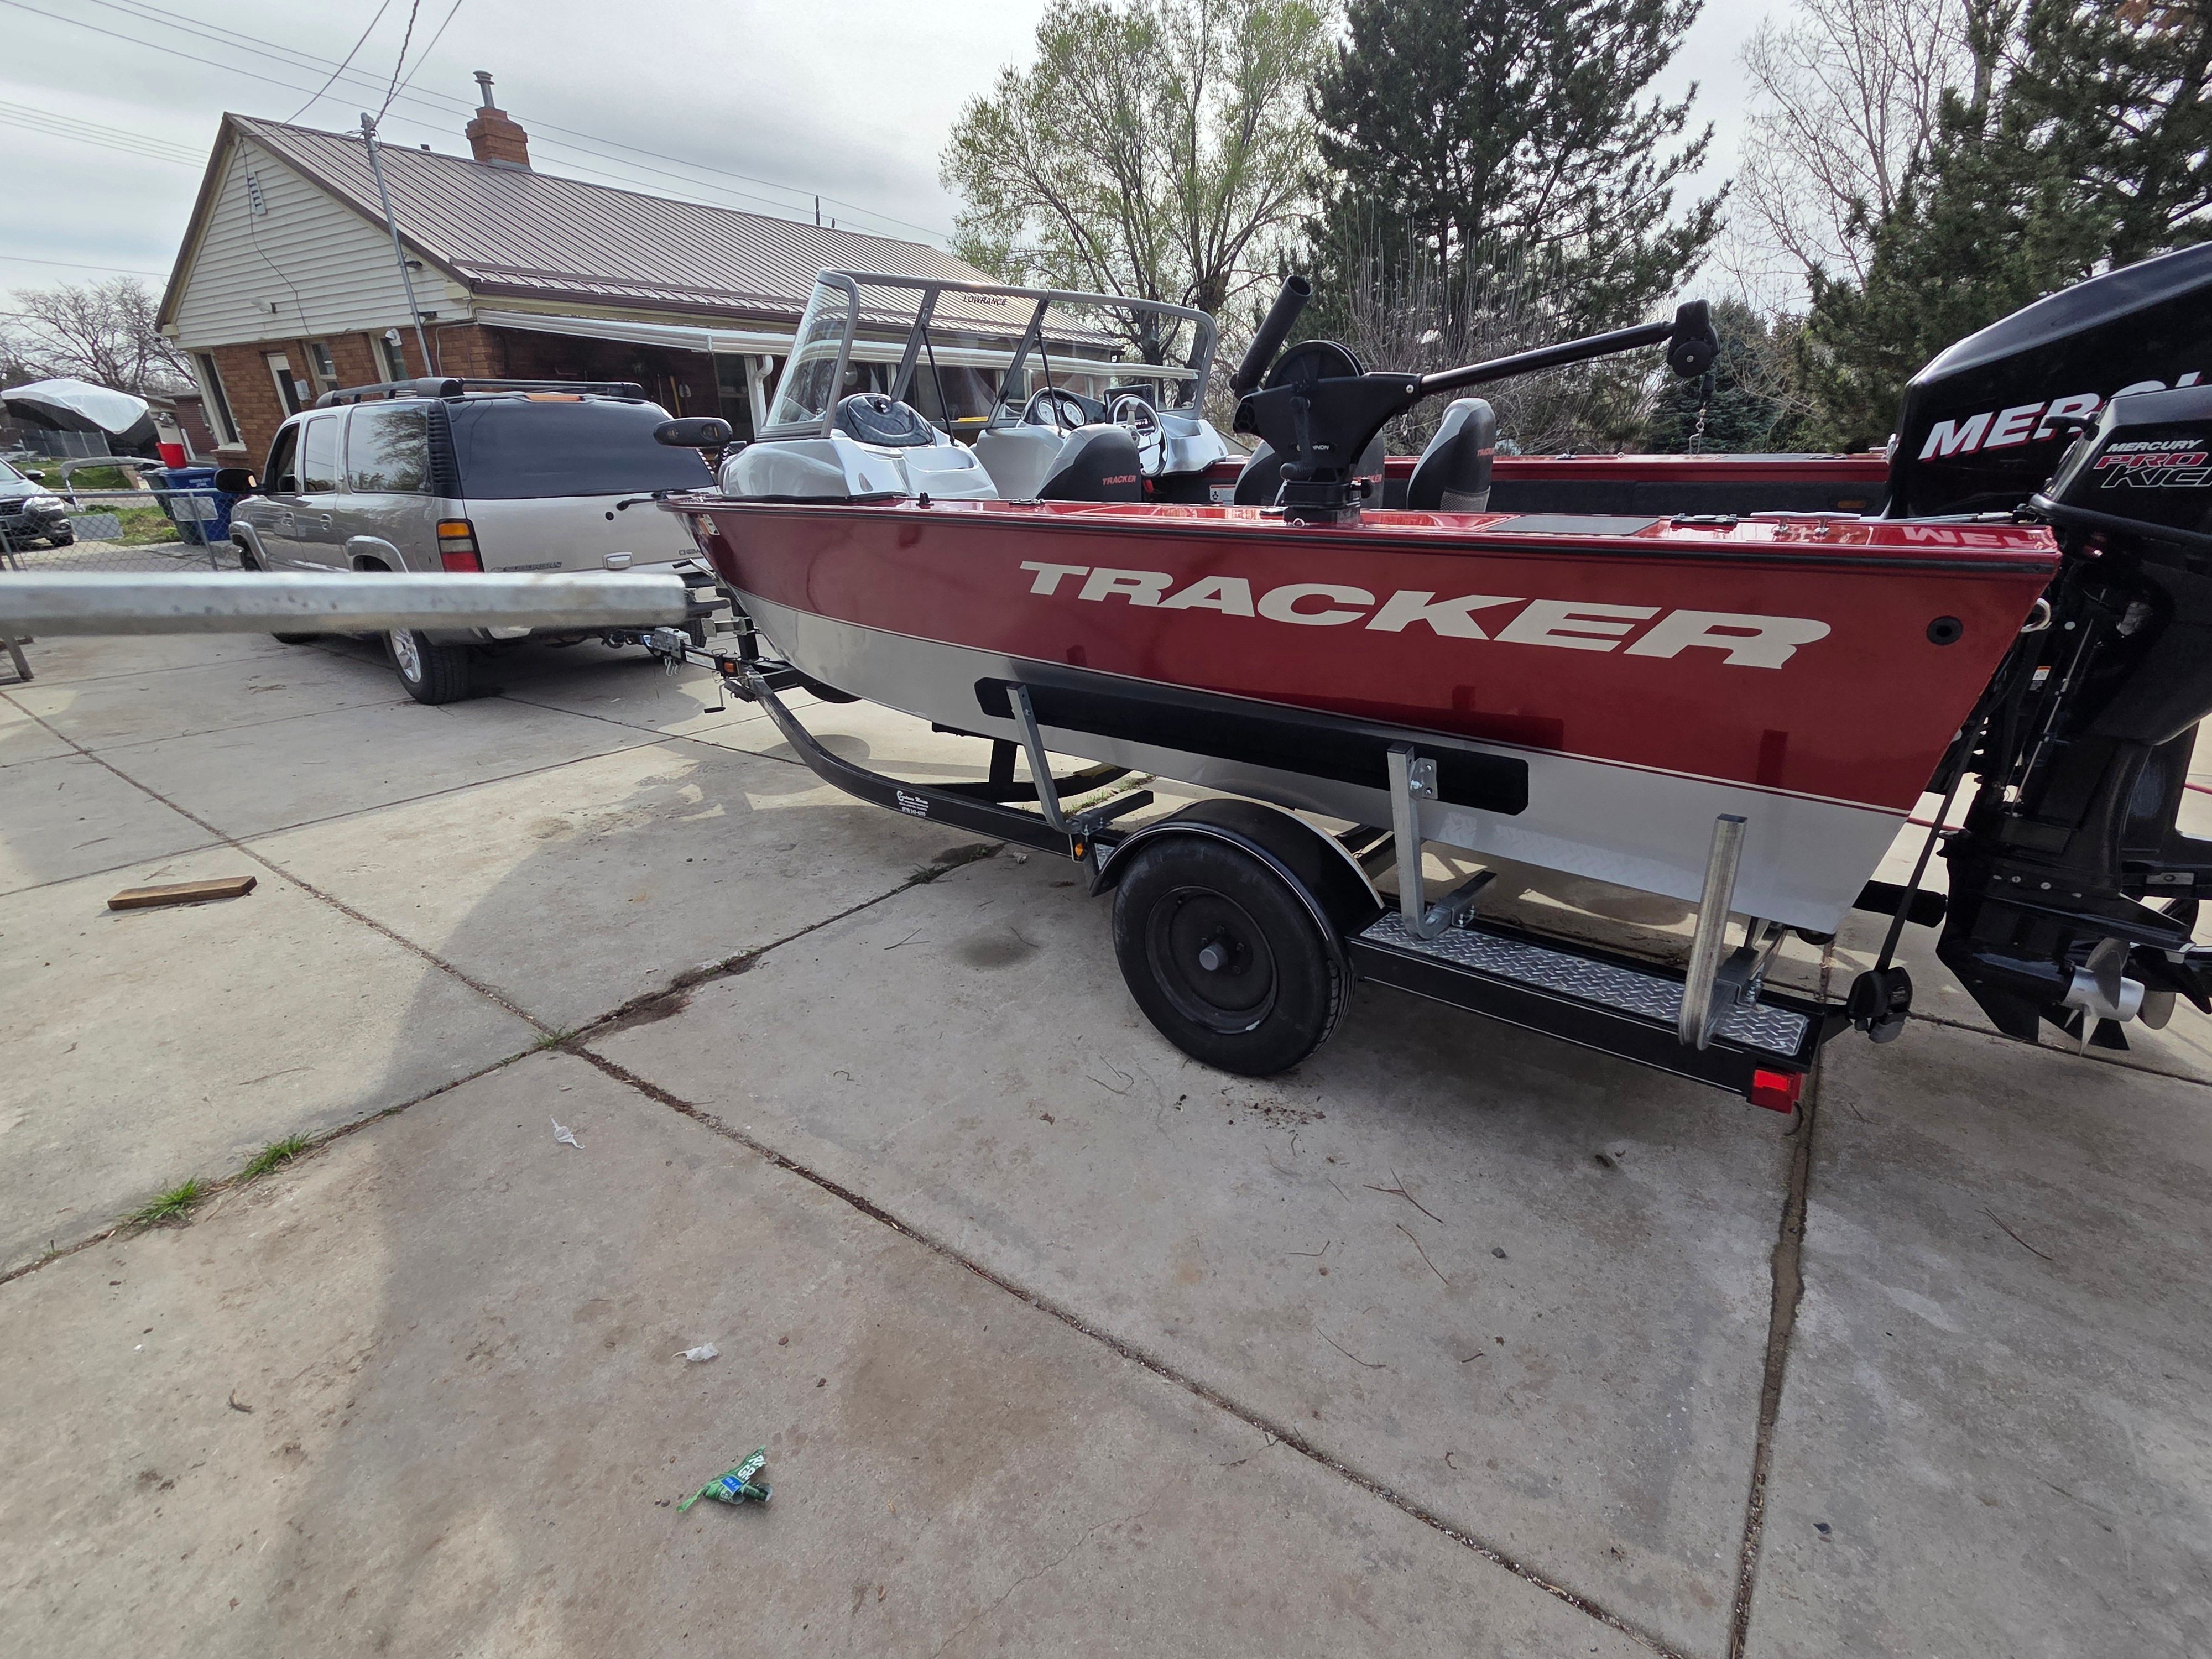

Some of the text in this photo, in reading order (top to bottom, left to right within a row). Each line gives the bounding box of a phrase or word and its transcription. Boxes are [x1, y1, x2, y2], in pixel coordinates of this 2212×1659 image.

[2106, 440, 2204, 452] MERCURY
[2093, 452, 2208, 469] PRO
[1102, 475, 1136, 486] TRACKER
[2100, 464, 2212, 488] KIC
[1019, 561, 1832, 670] TRACKER
